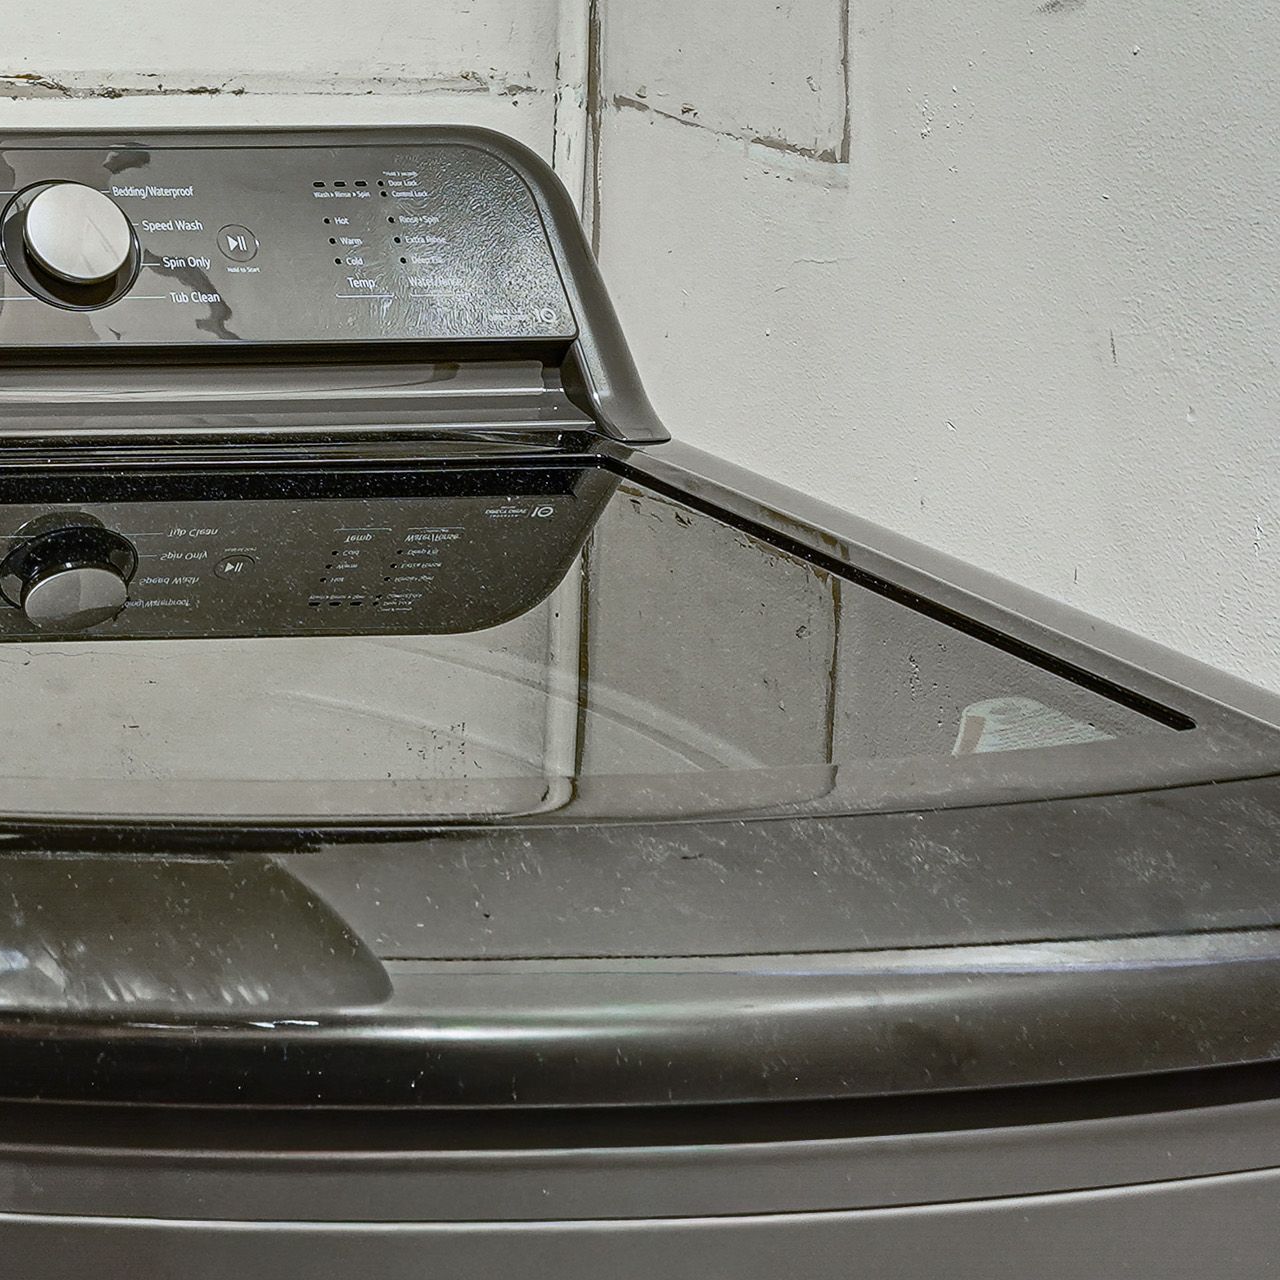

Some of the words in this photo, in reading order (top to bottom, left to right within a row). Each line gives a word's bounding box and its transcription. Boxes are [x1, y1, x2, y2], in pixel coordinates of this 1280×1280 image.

[112, 185, 194, 199] Bedding/Waterproof
[142, 220, 174, 233] Speed
[175, 220, 204, 231] Wash
[339, 236, 363, 245] Warm
[162, 256, 186, 270] Spin
[188, 256, 211, 270] Only
[345, 257, 364, 266] Cold
[347, 277, 378, 290] Temp.
[169, 293, 189, 303] Tub
[191, 291, 221, 303] Clean
